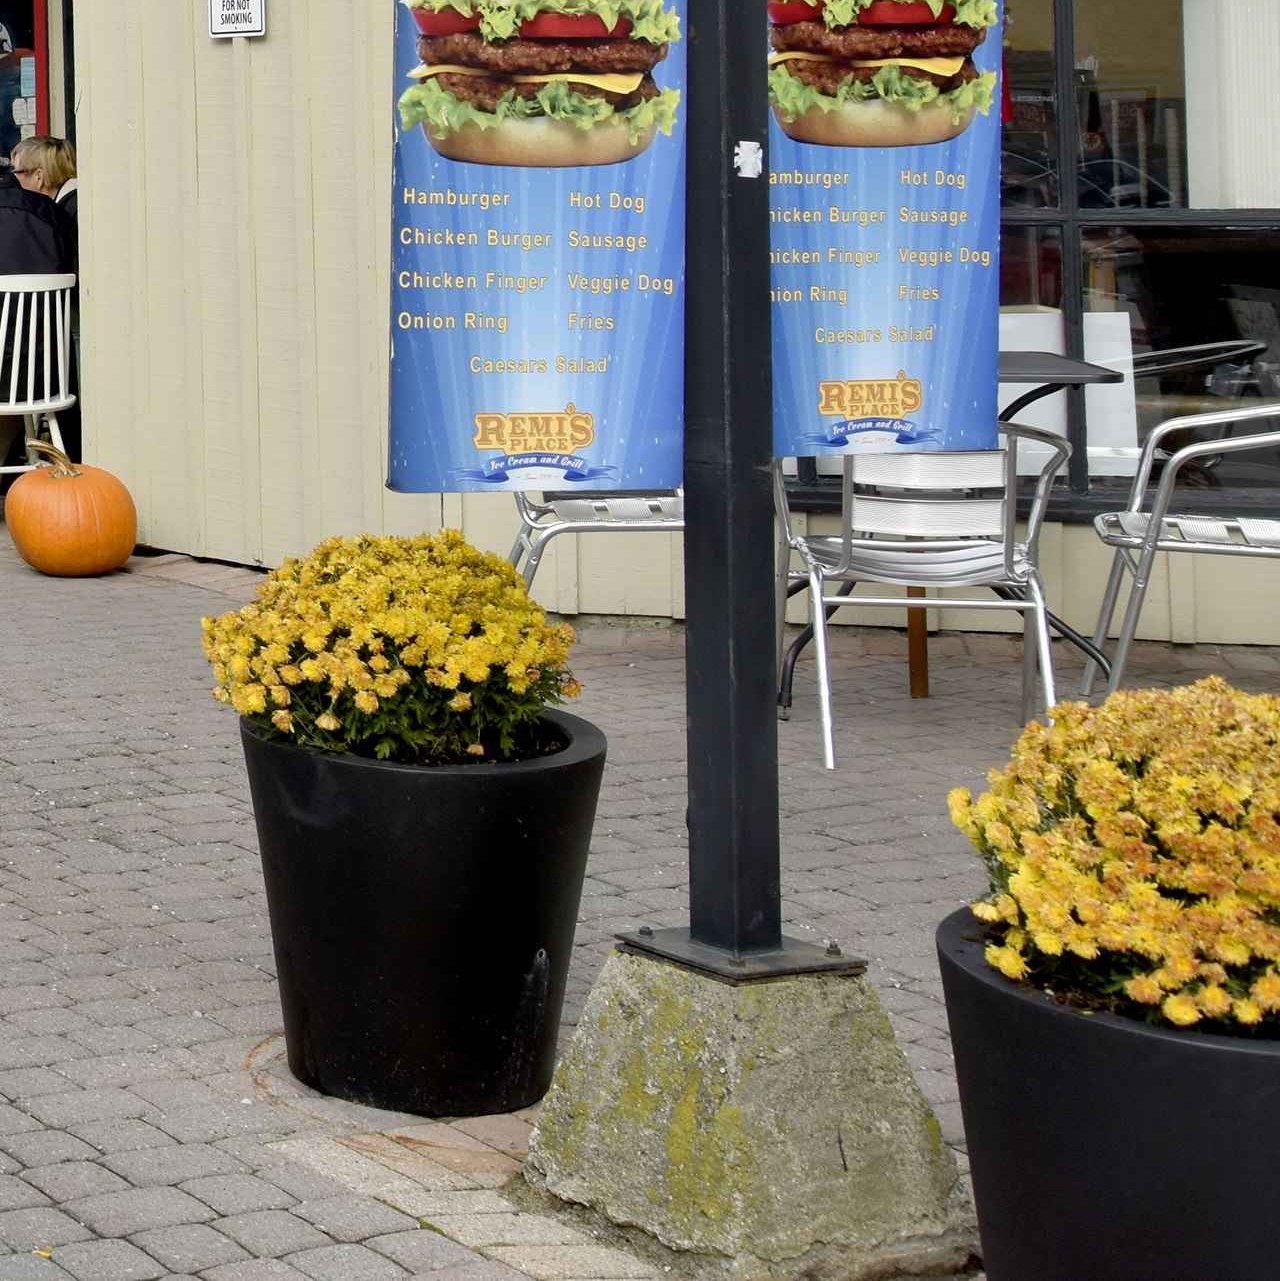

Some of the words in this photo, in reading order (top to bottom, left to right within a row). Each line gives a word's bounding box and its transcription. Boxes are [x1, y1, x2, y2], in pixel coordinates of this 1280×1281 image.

[222, 0, 236, 11] FOR
[237, 0, 250, 10] NOT
[220, 12, 252, 25] SMOKING
[769, 169, 849, 188] amburger
[900, 170, 928, 186] Hot
[935, 170, 966, 189] Dog
[403, 188, 511, 210] Hamburger
[569, 191, 601, 209] Hot
[609, 191, 646, 214] Dog
[829, 206, 885, 227] Burger
[899, 206, 968, 227] Sausage
[400, 228, 478, 246] Chicken
[487, 229, 552, 251] Burger
[568, 230, 648, 253] Sausage
[828, 248, 881, 267] Finger
[899, 248, 953, 267] Veggie
[960, 248, 991, 266] Dog
[398, 271, 477, 289] Chicken
[485, 272, 547, 294] Finger
[568, 273, 630, 295] Veggie
[638, 274, 674, 295] Dog
[810, 286, 848, 305] Ring
[899, 285, 940, 301] Fries
[398, 311, 456, 329] Onion
[464, 312, 508, 334] Ring
[568, 312, 615, 330] Fries
[815, 326, 882, 343] Caesars
[888, 325, 935, 342] Salad
[470, 355, 547, 374] Caesars
[555, 355, 609, 373] Salad
[821, 369, 922, 411] REMI'S
[849, 404, 900, 416] PLACE
[477, 402, 592, 446] REMI'S
[833, 425, 845, 435] Ice
[848, 421, 874, 431] Cream
[875, 420, 891, 429] and
[893, 421, 913, 433] Grill
[509, 438, 568, 451] PLACE
[491, 460, 505, 471] Ice
[508, 456, 538, 466] Cream
[540, 455, 559, 464] and
[561, 457, 584, 468] Grill
